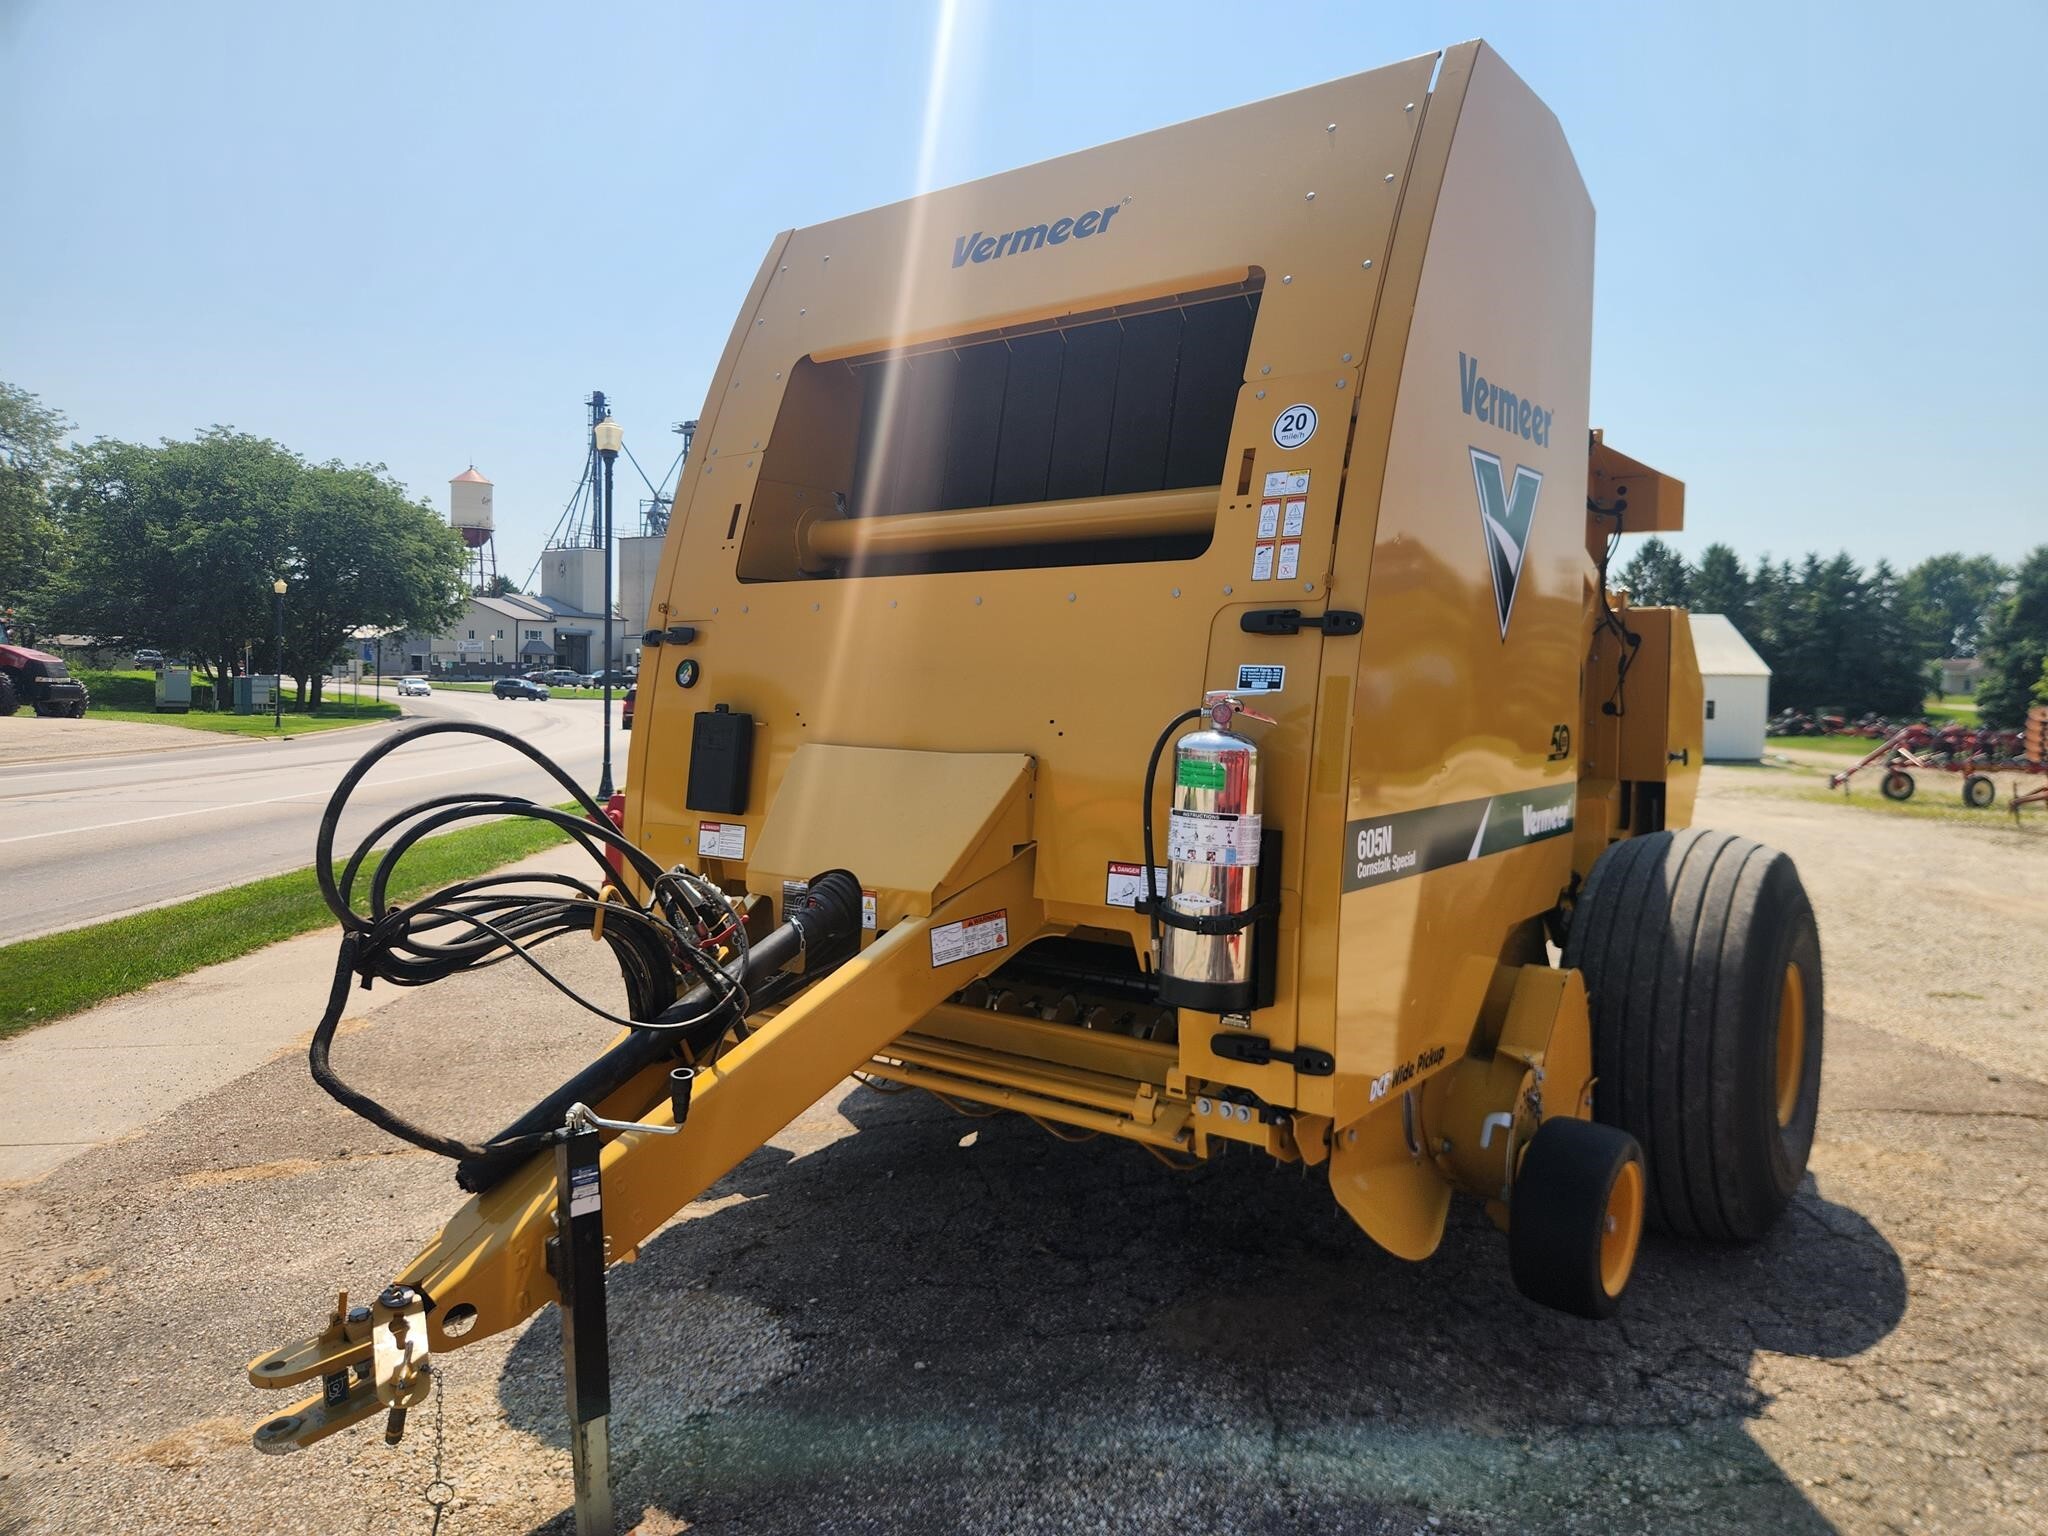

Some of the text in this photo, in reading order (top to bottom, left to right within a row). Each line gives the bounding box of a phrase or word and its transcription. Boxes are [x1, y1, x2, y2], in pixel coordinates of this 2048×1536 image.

[952, 203, 1121, 269] Vermeer
[1459, 351, 1552, 449] Vermeer
[1281, 413, 1308, 432] 20
[1357, 825, 1392, 860] 605N
[1117, 865, 1140, 874] DANGER
[1357, 850, 1416, 879] Cornstalk Special
[1391, 1060, 1415, 1088] Wide
[1416, 1046, 1446, 1074] Pickup
